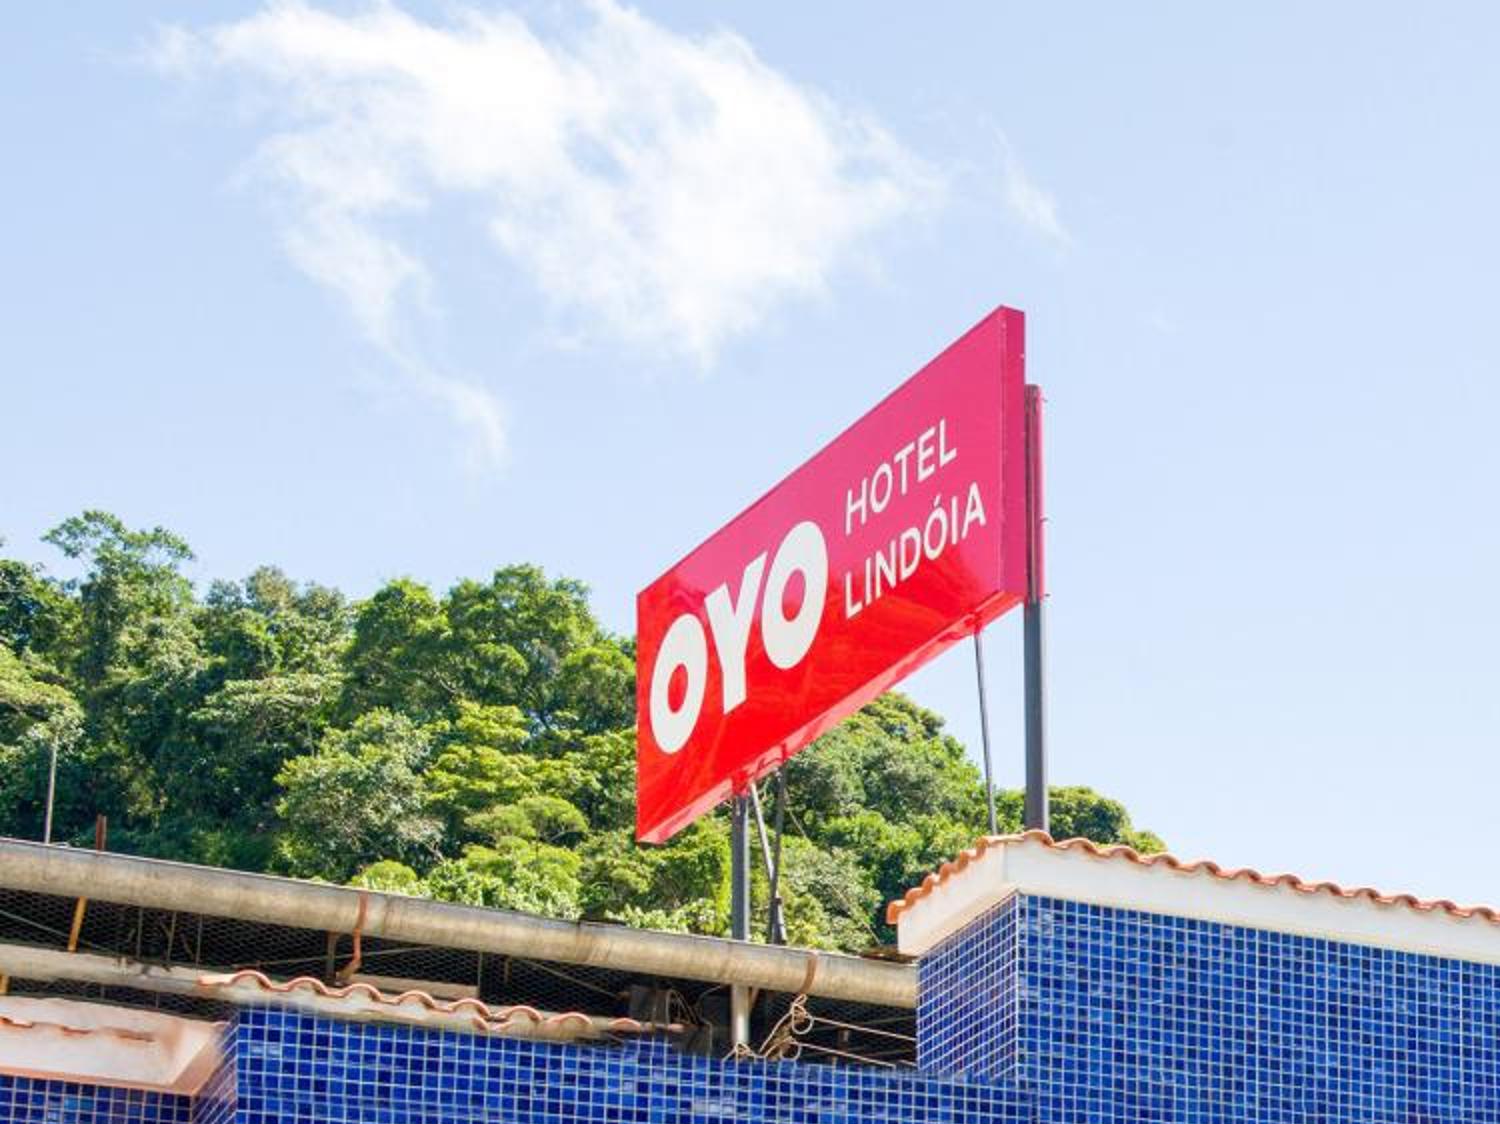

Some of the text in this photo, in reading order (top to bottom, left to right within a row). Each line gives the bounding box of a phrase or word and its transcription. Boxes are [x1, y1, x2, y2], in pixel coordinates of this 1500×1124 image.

[845, 419, 957, 535] HOTEL
[843, 482, 987, 620] LINDÓIA
[649, 520, 829, 754] OYO
